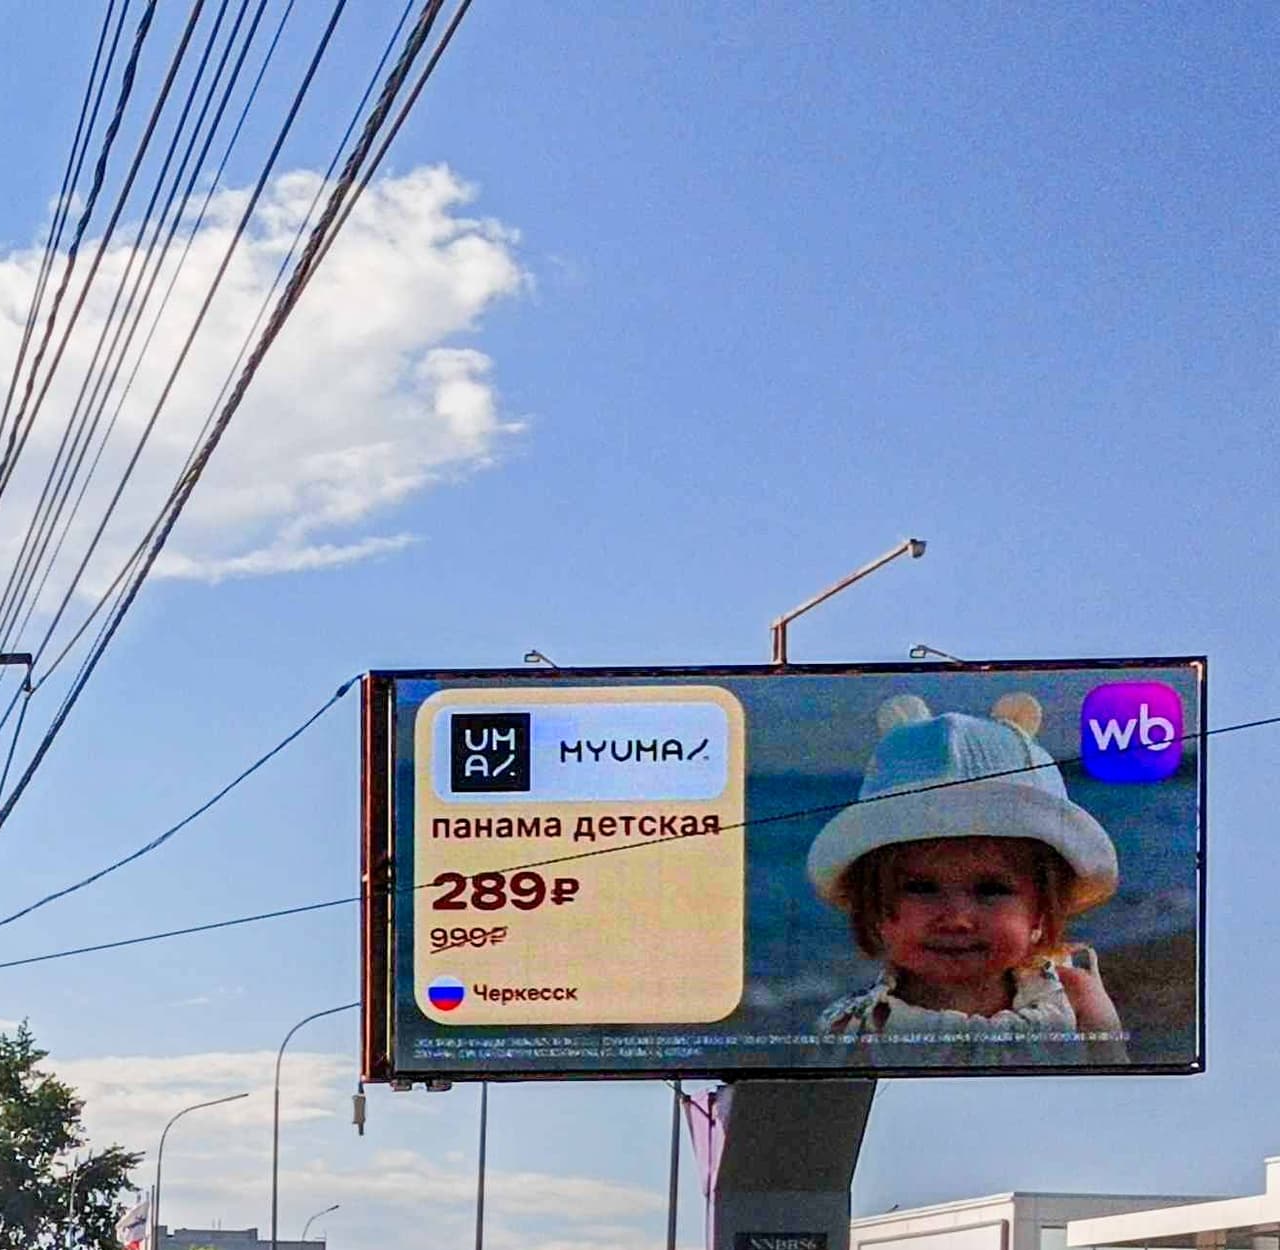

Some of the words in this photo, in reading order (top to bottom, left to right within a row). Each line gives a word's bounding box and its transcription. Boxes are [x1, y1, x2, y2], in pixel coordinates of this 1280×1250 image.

[1088, 703, 1175, 752] wb
[432, 816, 562, 839] панама
[573, 814, 721, 843] детская
[473, 983, 578, 1005] Черкесск
